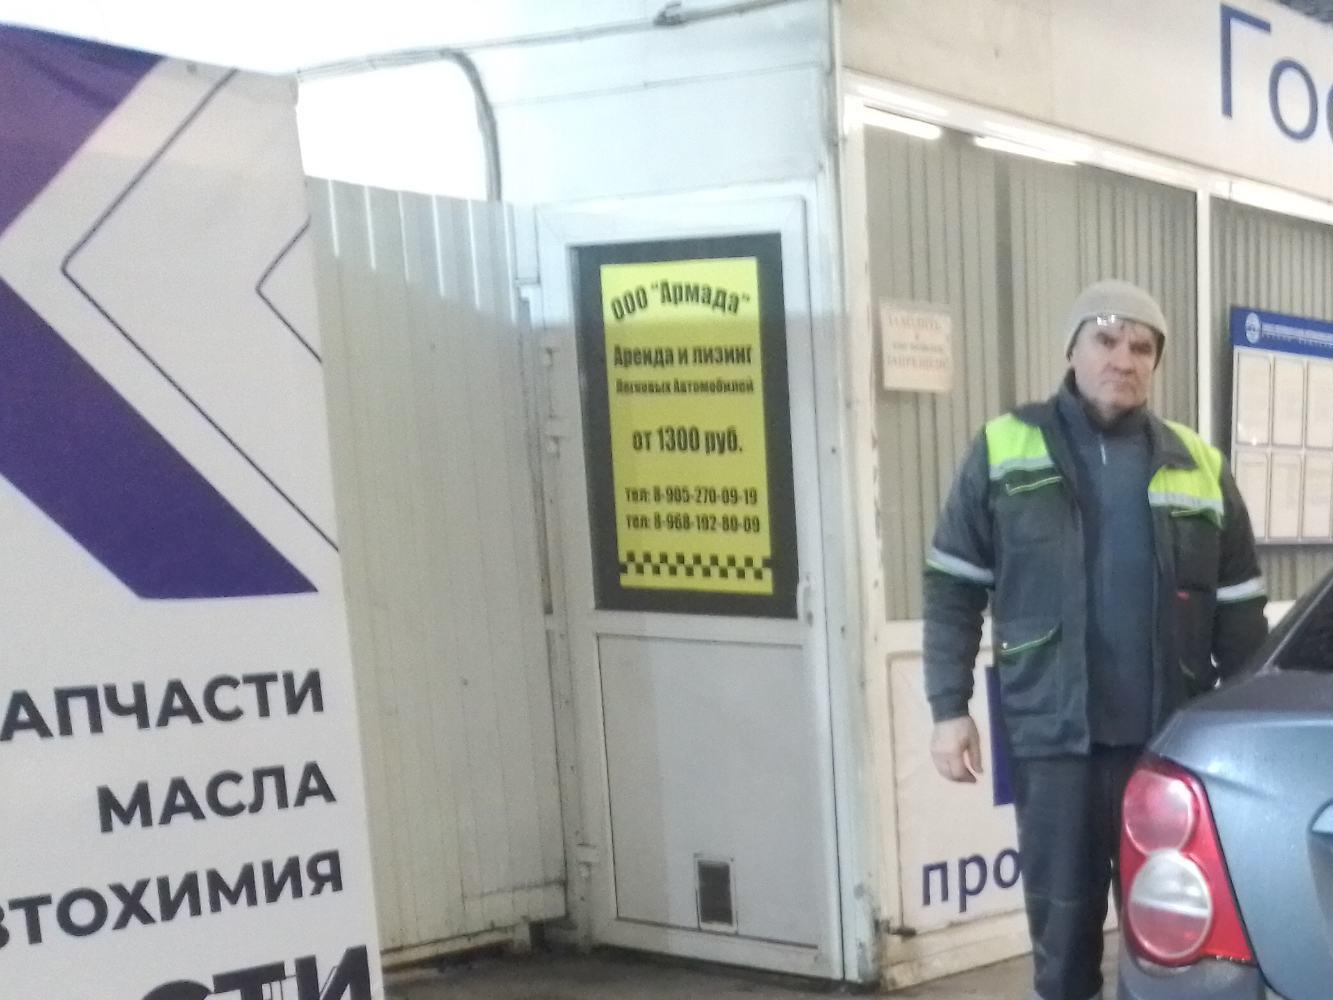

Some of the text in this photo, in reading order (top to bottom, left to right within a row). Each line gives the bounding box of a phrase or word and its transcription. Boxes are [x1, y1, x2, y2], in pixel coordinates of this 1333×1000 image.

[611, 284, 649, 322] ООО
[614, 344, 752, 367] Аренда и лизинг
[632, 425, 743, 455] от 1300 руб.
[0, 668, 325, 741] АПЧАСТИ
[97, 761, 337, 833] МАСЛА
[0, 849, 344, 948] ТОХИМИЯ
